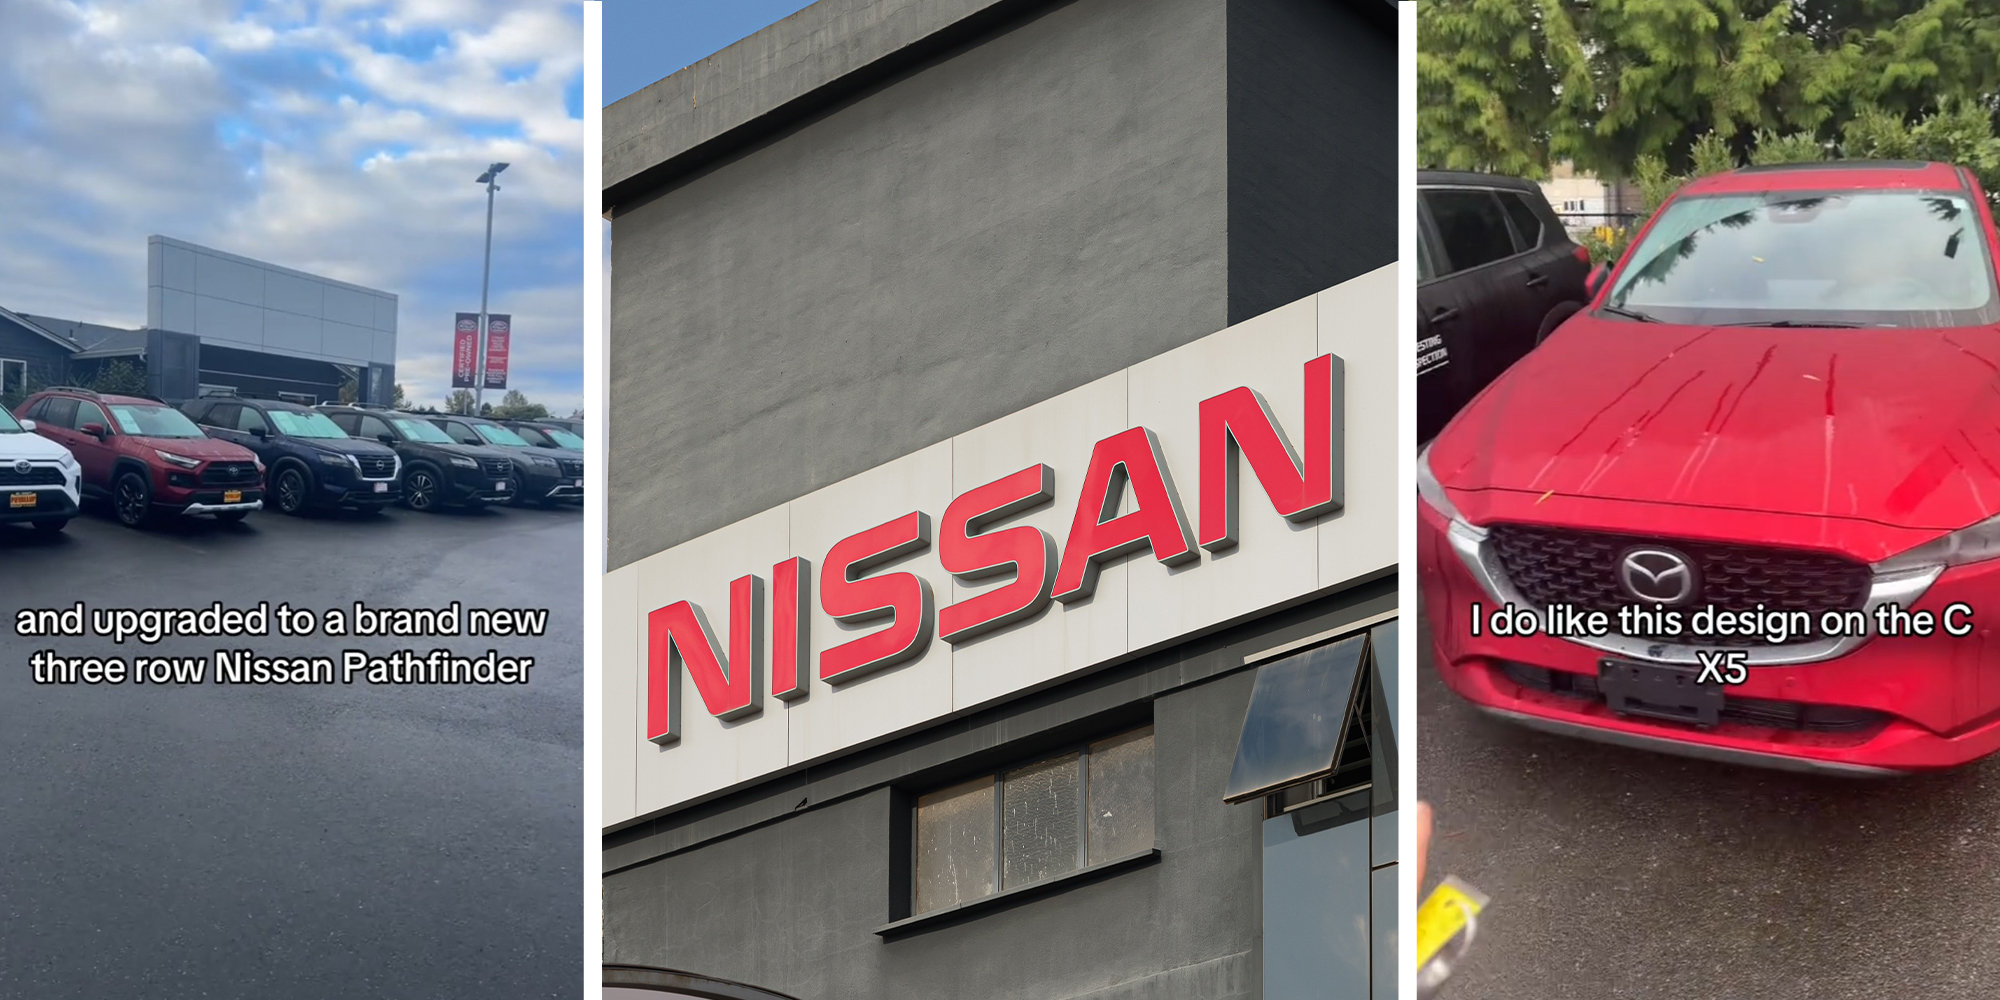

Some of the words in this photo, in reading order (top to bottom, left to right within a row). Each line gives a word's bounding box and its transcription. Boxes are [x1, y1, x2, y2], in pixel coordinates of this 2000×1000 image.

[458, 339, 466, 378] CERTIFIED
[464, 335, 473, 382] PRE-OWNED
[647, 353, 1343, 744] NISSAN
